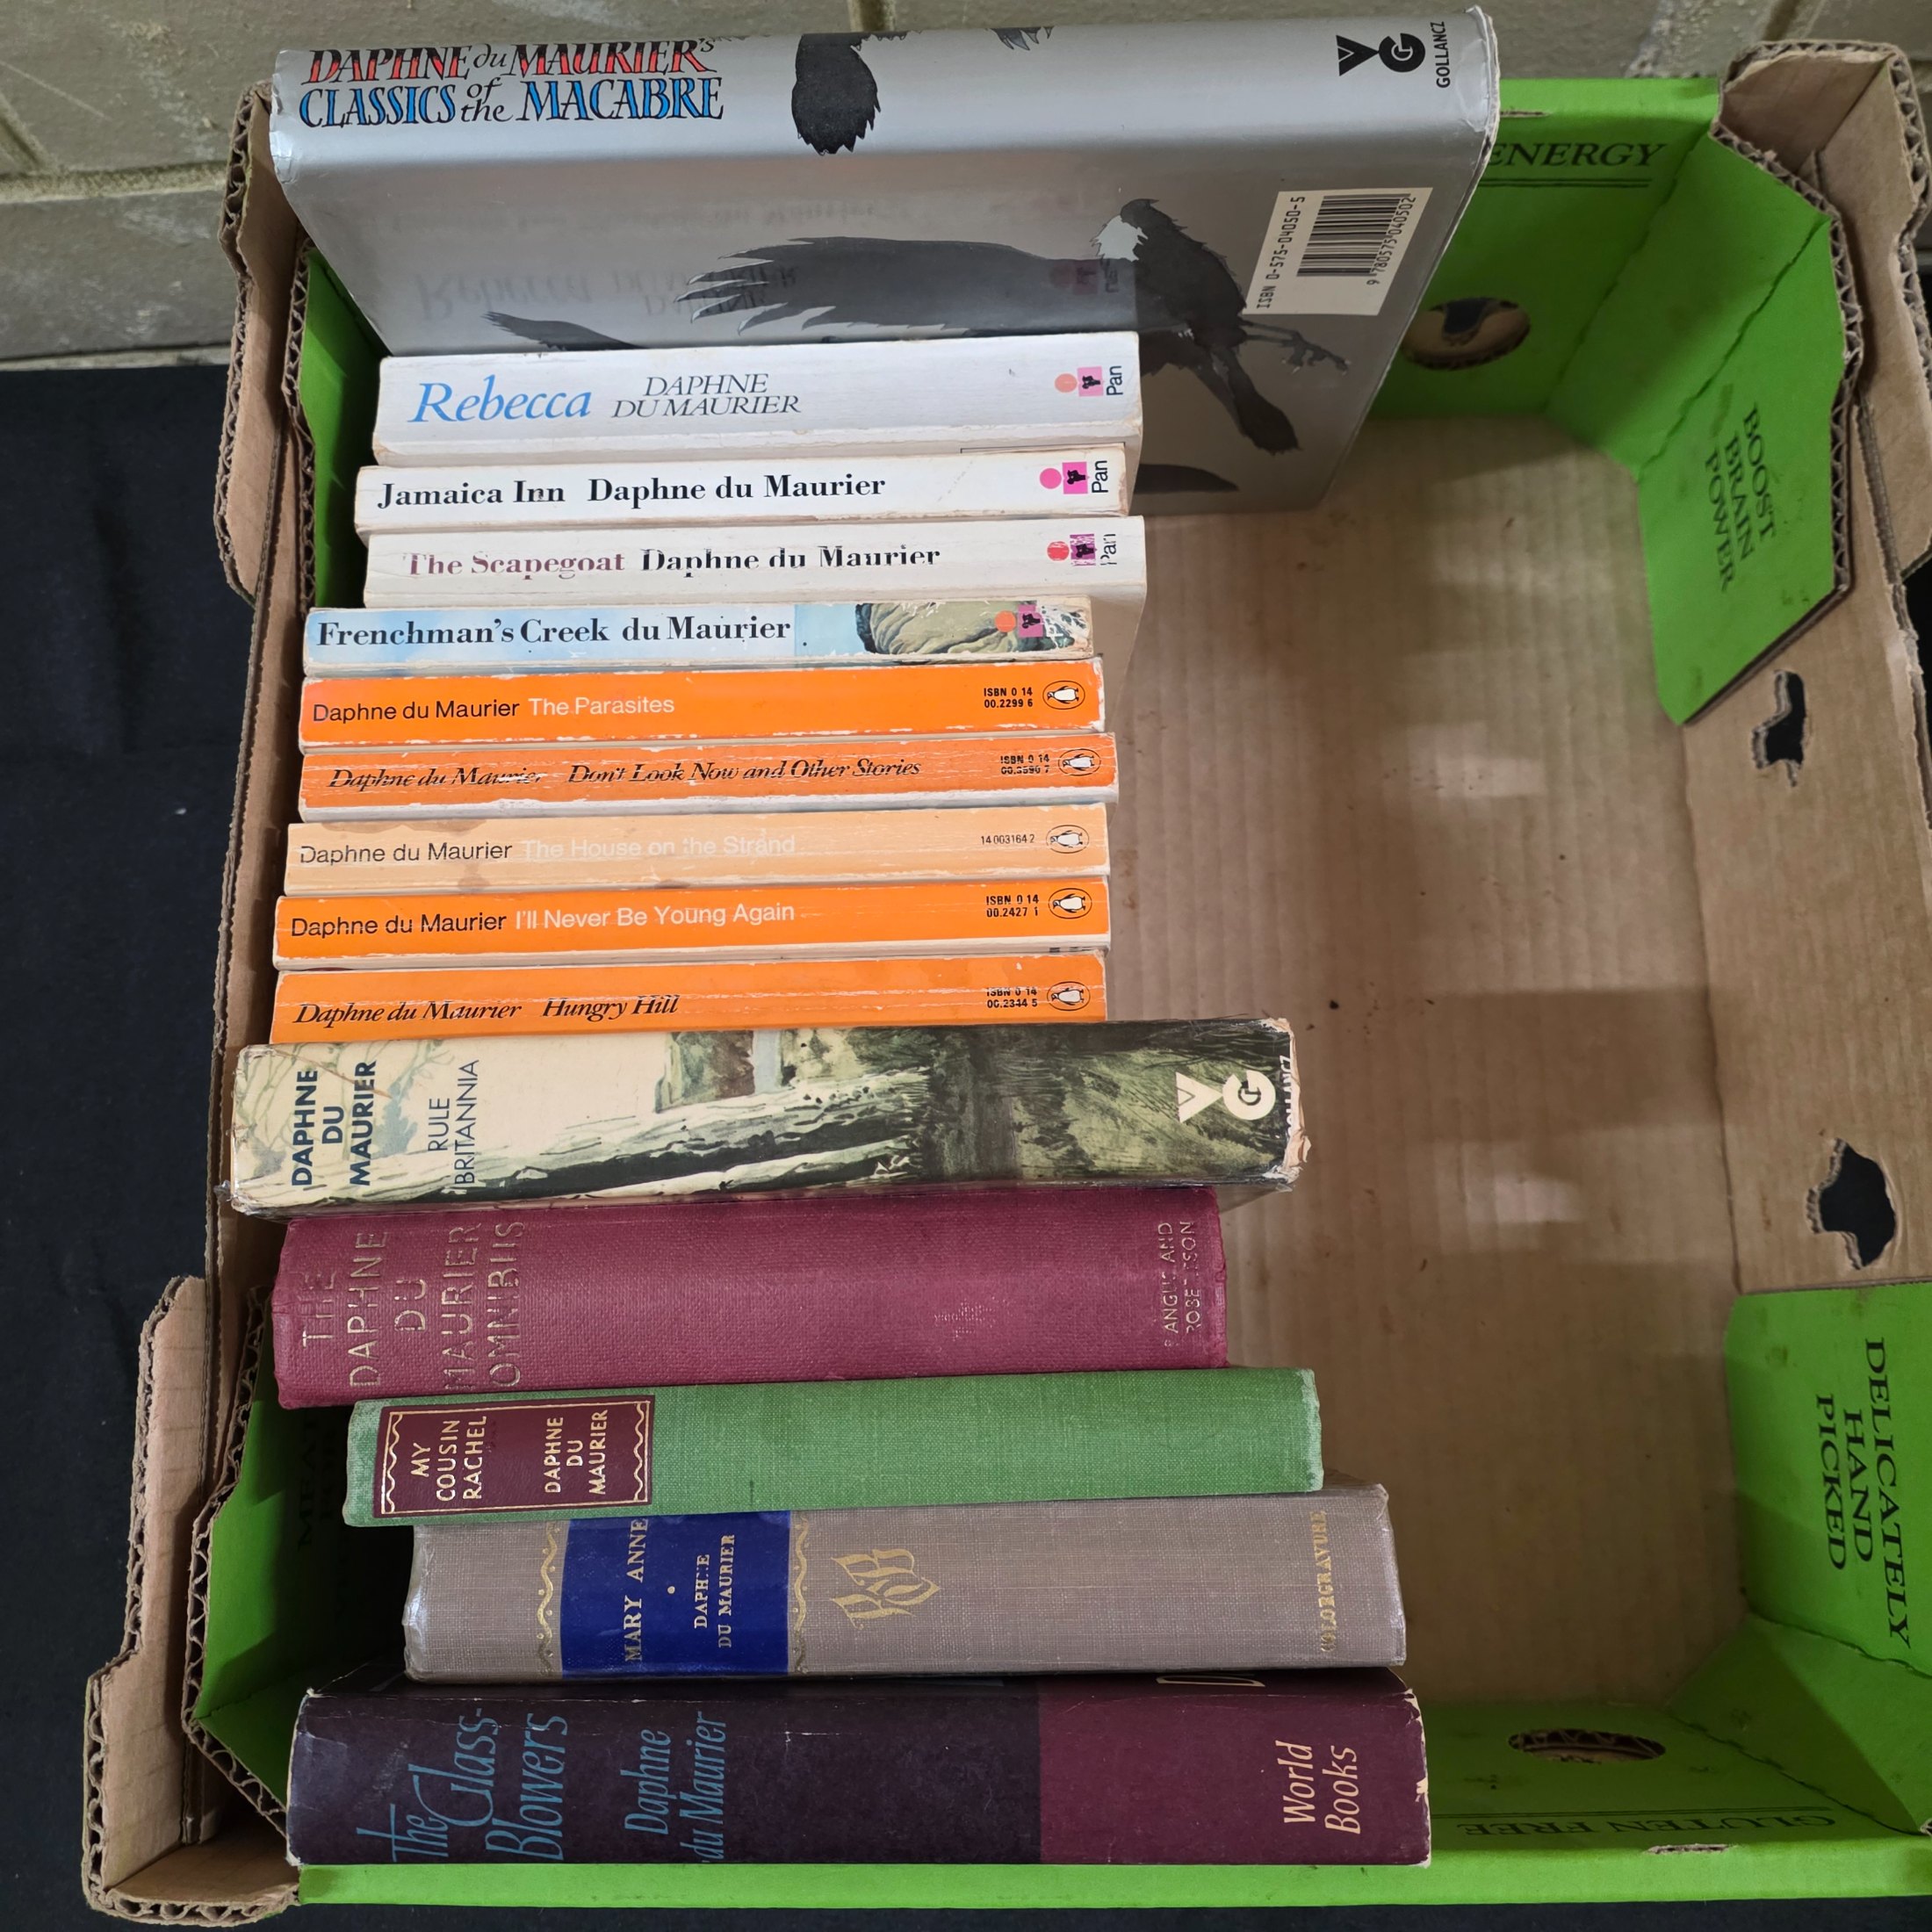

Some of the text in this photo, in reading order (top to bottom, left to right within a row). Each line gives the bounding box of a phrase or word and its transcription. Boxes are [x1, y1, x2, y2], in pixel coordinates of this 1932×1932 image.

[301, 38, 717, 85] DAPHNE du MAURIER's
[1430, 20, 1451, 89] GOLLANCZ
[299, 76, 724, 128] CLASSICS of the MACABRE
[1488, 142, 1669, 167] ENERGY
[1256, 196, 1306, 309] ISBN 0-575-04050-5
[407, 374, 593, 422] Rebecca
[642, 373, 770, 396] DAPHNE
[1107, 365, 1123, 395] Pan
[611, 394, 802, 419] DU MAURIER
[377, 472, 886, 509] Jamaica Inn Daphne du Maurier
[1091, 459, 1108, 494] Pan
[1725, 436, 1755, 559] BRAIN
[1743, 401, 1775, 542] BOOST
[1705, 447, 1737, 594] POWER
[403, 544, 941, 580] The Scapegoat Daphne du Maurier
[1100, 534, 1117, 566] Pan
[315, 615, 791, 647] Frenchman's Creek du Maurier
[313, 695, 676, 724] Daphne du Maurier The Parasites
[984, 687, 1034, 696] ISBN 0 14
[984, 698, 1034, 709] 00.2299 6
[329, 758, 922, 792] Daphne du Maurier Don't Look Now and Other Stories
[1000, 754, 1050, 764] ISBN 0 14
[299, 834, 796, 866] Daphne du Maurier The House on the Strand
[291, 904, 796, 939] Daphne du Maurier I'll Never Be Young Again
[986, 894, 1039, 905] ISBN 0 14
[986, 907, 1039, 917] 00.2427 1
[292, 994, 681, 1027] Daphne du Maurier Hungry Hill
[986, 987, 1011, 997] ISBN
[1027, 987, 1038, 996] 14
[1031, 998, 1038, 1007] 5
[291, 1070, 318, 1186] DAPHNE
[322, 1106, 344, 1143] DU
[349, 1060, 378, 1186] MAURIER
[428, 1098, 450, 1151] RULE
[454, 1059, 479, 1185] BRITANNIA
[1157, 1222, 1176, 1264] AND
[348, 1230, 387, 1388] DAPHNE
[393, 1279, 428, 1333] DU
[442, 1222, 481, 1391] MAURIER
[487, 1221, 525, 1388] OMNIBUS
[410, 1442, 431, 1478] MY
[436, 1419, 460, 1502] COUSIN
[462, 1415, 487, 1500] RACHEL
[544, 1416, 564, 1494] DAPHNE
[566, 1439, 584, 1467] DU
[588, 1409, 609, 1495] MAURIER
[1815, 1394, 1848, 1571] PICKED
[1843, 1409, 1873, 1563] HAND
[1864, 1337, 1911, 1648] DELICATELY
[624, 1519, 648, 1662] MARY ANNE
[695, 1554, 710, 1629] DAPHE
[717, 1534, 735, 1648] DU MAURIER
[486, 1713, 568, 1861] Blowers
[620, 1729, 671, 1835] Daphne
[680, 1711, 727, 1863] du Maurier
[1275, 1741, 1316, 1825] World
[1323, 1744, 1361, 1835] Books
[357, 1803, 449, 1862] The
[1455, 1814, 1837, 1837] GLUTEN FREE
